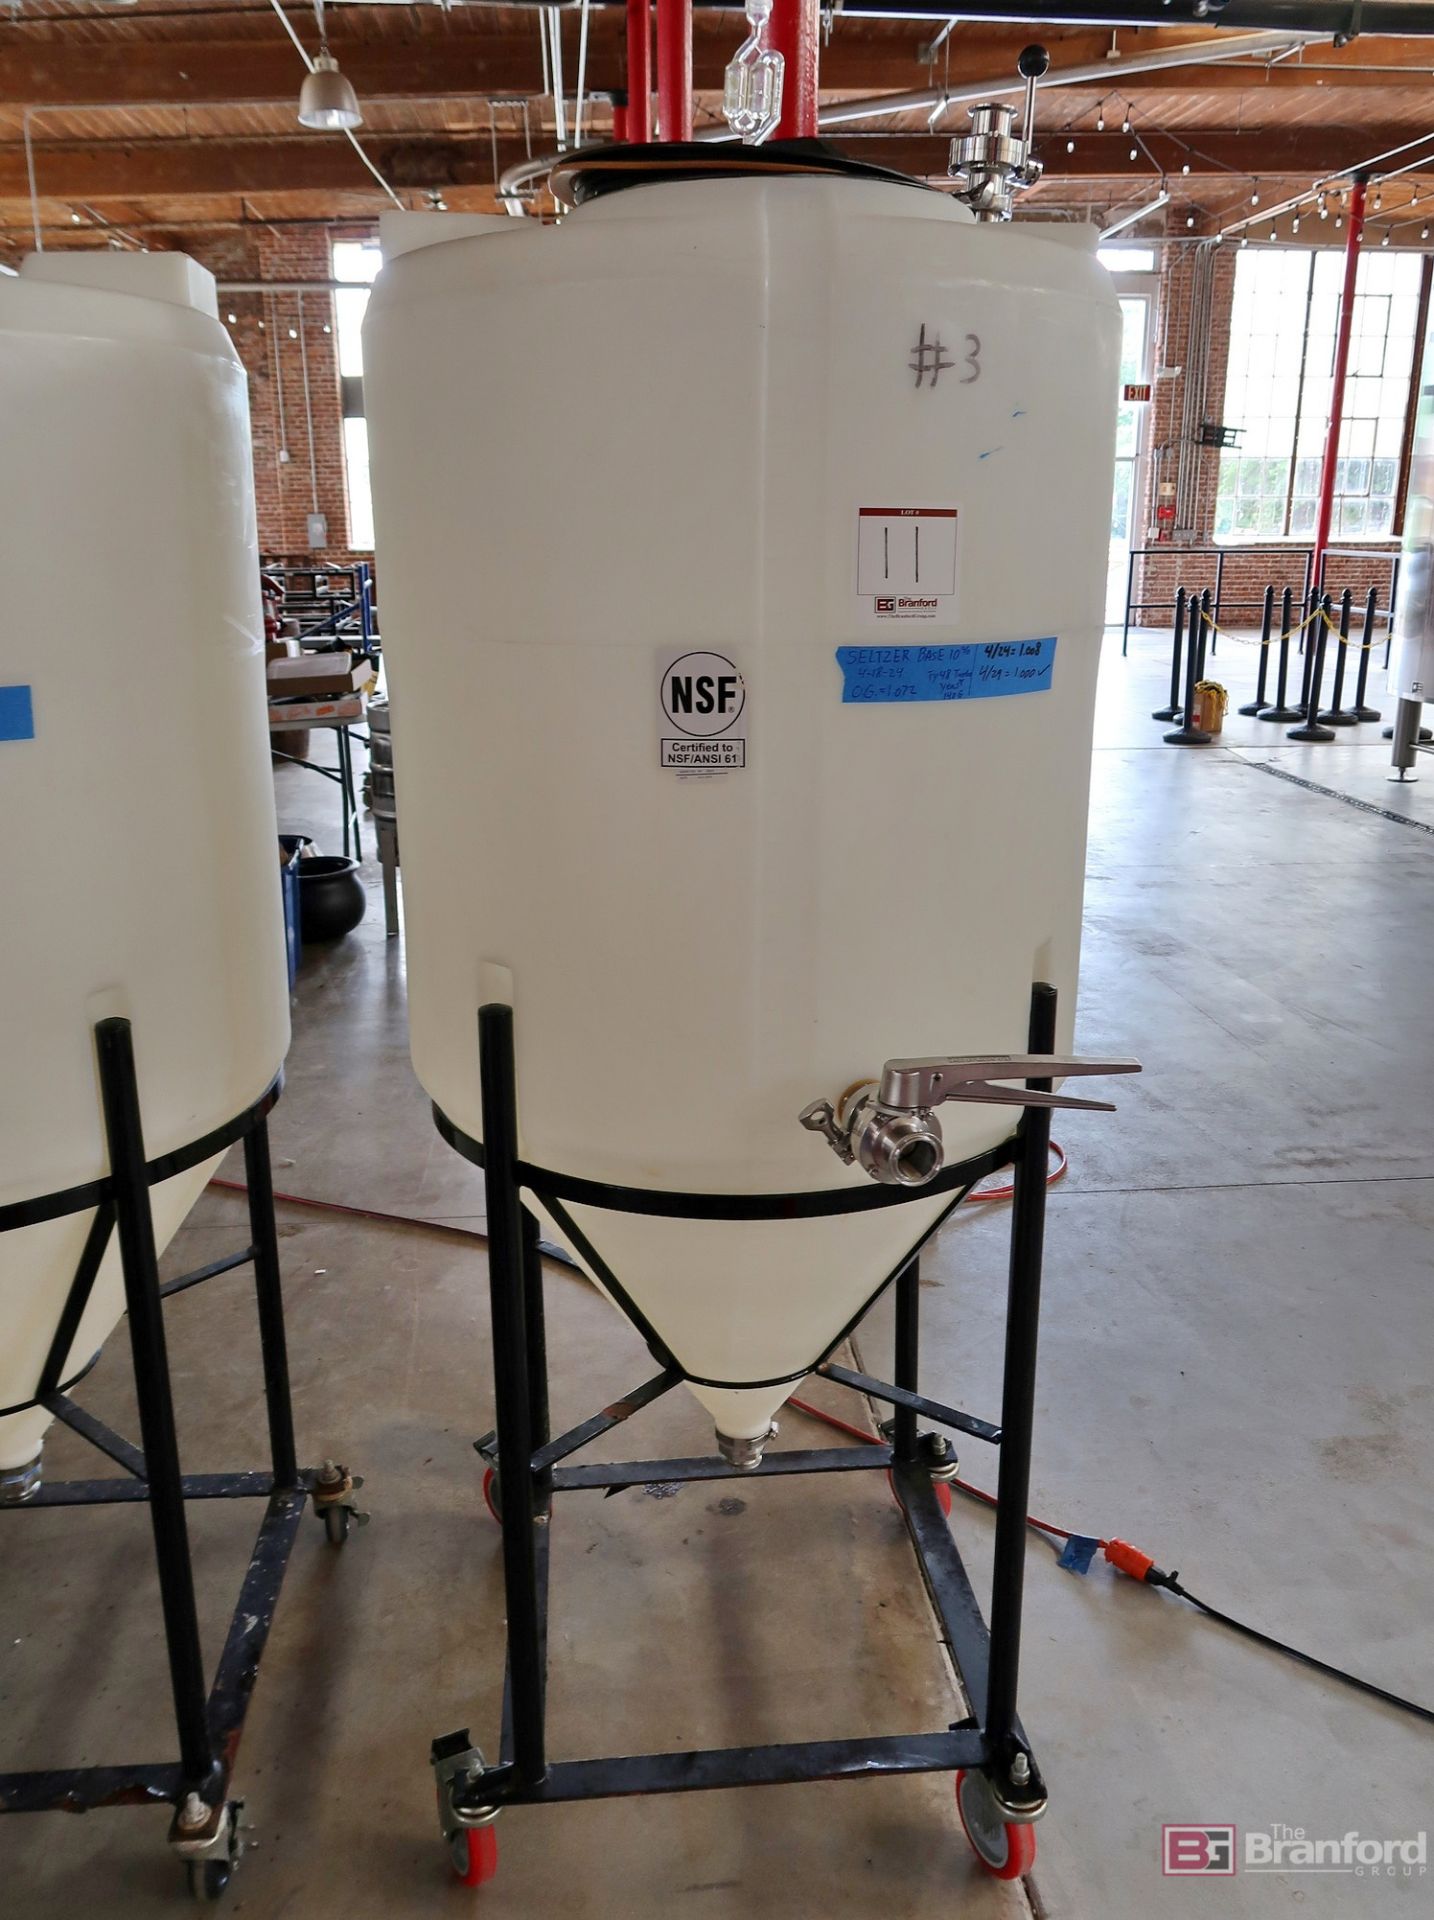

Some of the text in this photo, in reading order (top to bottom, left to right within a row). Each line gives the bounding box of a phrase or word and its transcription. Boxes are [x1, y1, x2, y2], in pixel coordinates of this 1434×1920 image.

[908, 323, 981, 388] #3
[1127, 385, 1147, 400] EXIT
[898, 598, 938, 607] Branford
[847, 649, 910, 665] SELTZER
[916, 646, 945, 662] BASE
[672, 742, 733, 752] Certified to
[668, 754, 737, 763] NSF/ANSI 61
